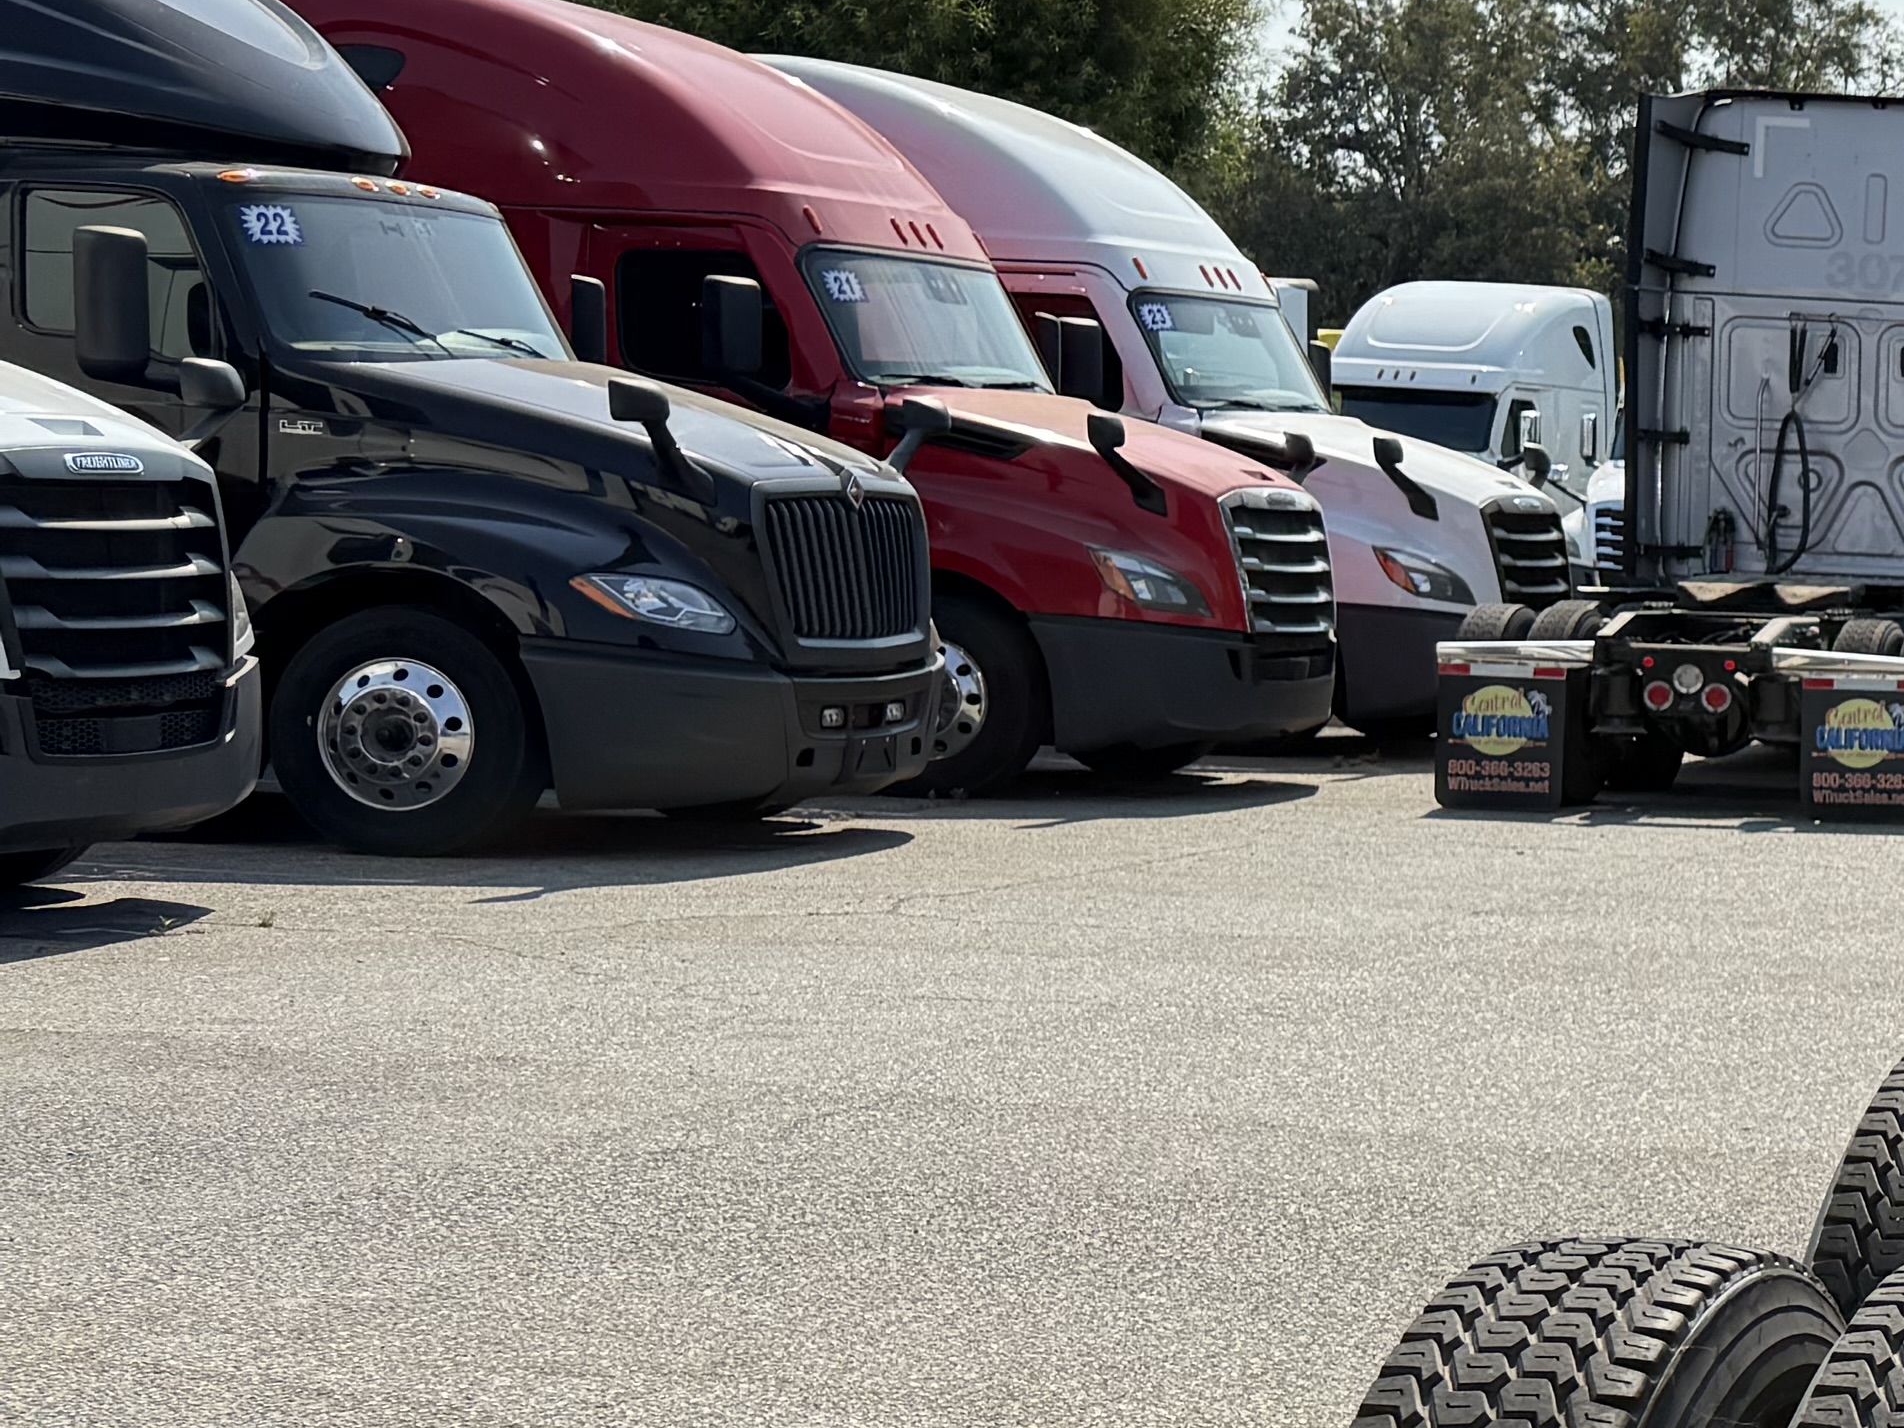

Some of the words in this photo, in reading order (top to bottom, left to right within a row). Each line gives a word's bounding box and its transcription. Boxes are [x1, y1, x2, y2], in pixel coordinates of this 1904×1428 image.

[256, 212, 289, 237] 22
[833, 275, 856, 296] 21
[1147, 308, 1167, 326] 23
[1453, 711, 1549, 739] CALIFORNIA
